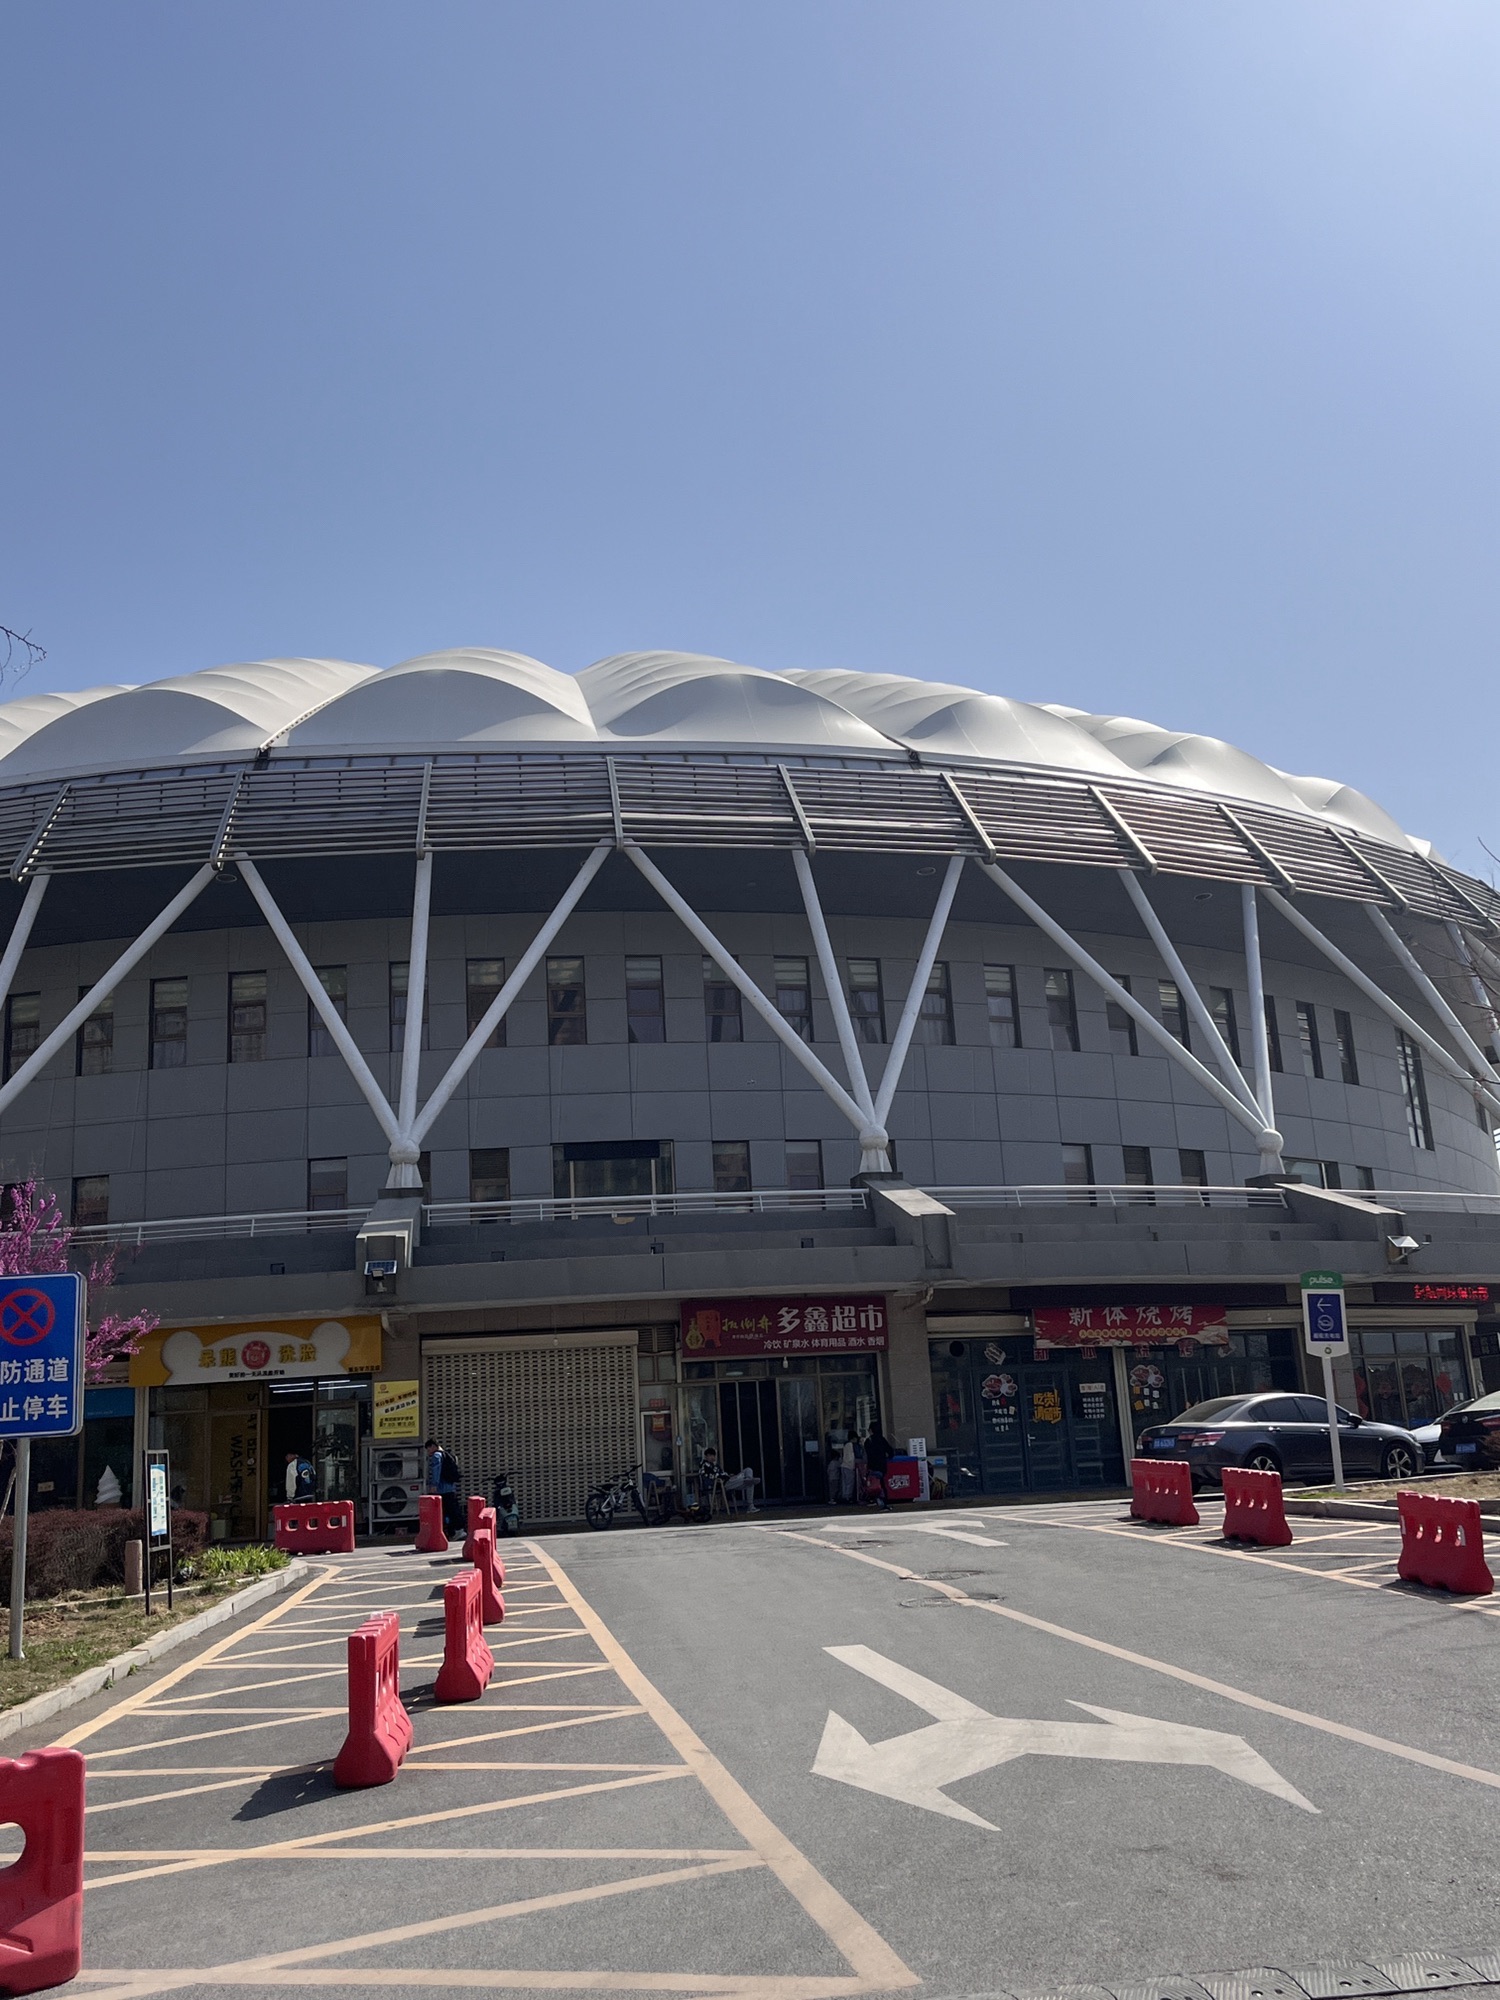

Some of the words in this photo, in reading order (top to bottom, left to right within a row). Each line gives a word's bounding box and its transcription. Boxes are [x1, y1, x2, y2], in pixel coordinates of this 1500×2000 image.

[1309, 1275, 1334, 1286] pulse
[777, 1304, 884, 1334] 多鑫超市
[1068, 1305, 1194, 1328] 新体烧烤
[763, 1339, 782, 1350] 冷饮
[783, 1338, 810, 1349] 矿泉水
[811, 1337, 847, 1348] 体育用品
[848, 1337, 866, 1347] 酒水
[867, 1336, 885, 1346] 香烟
[0, 1357, 69, 1385] 防通道
[0, 1394, 68, 1421] 止停车
